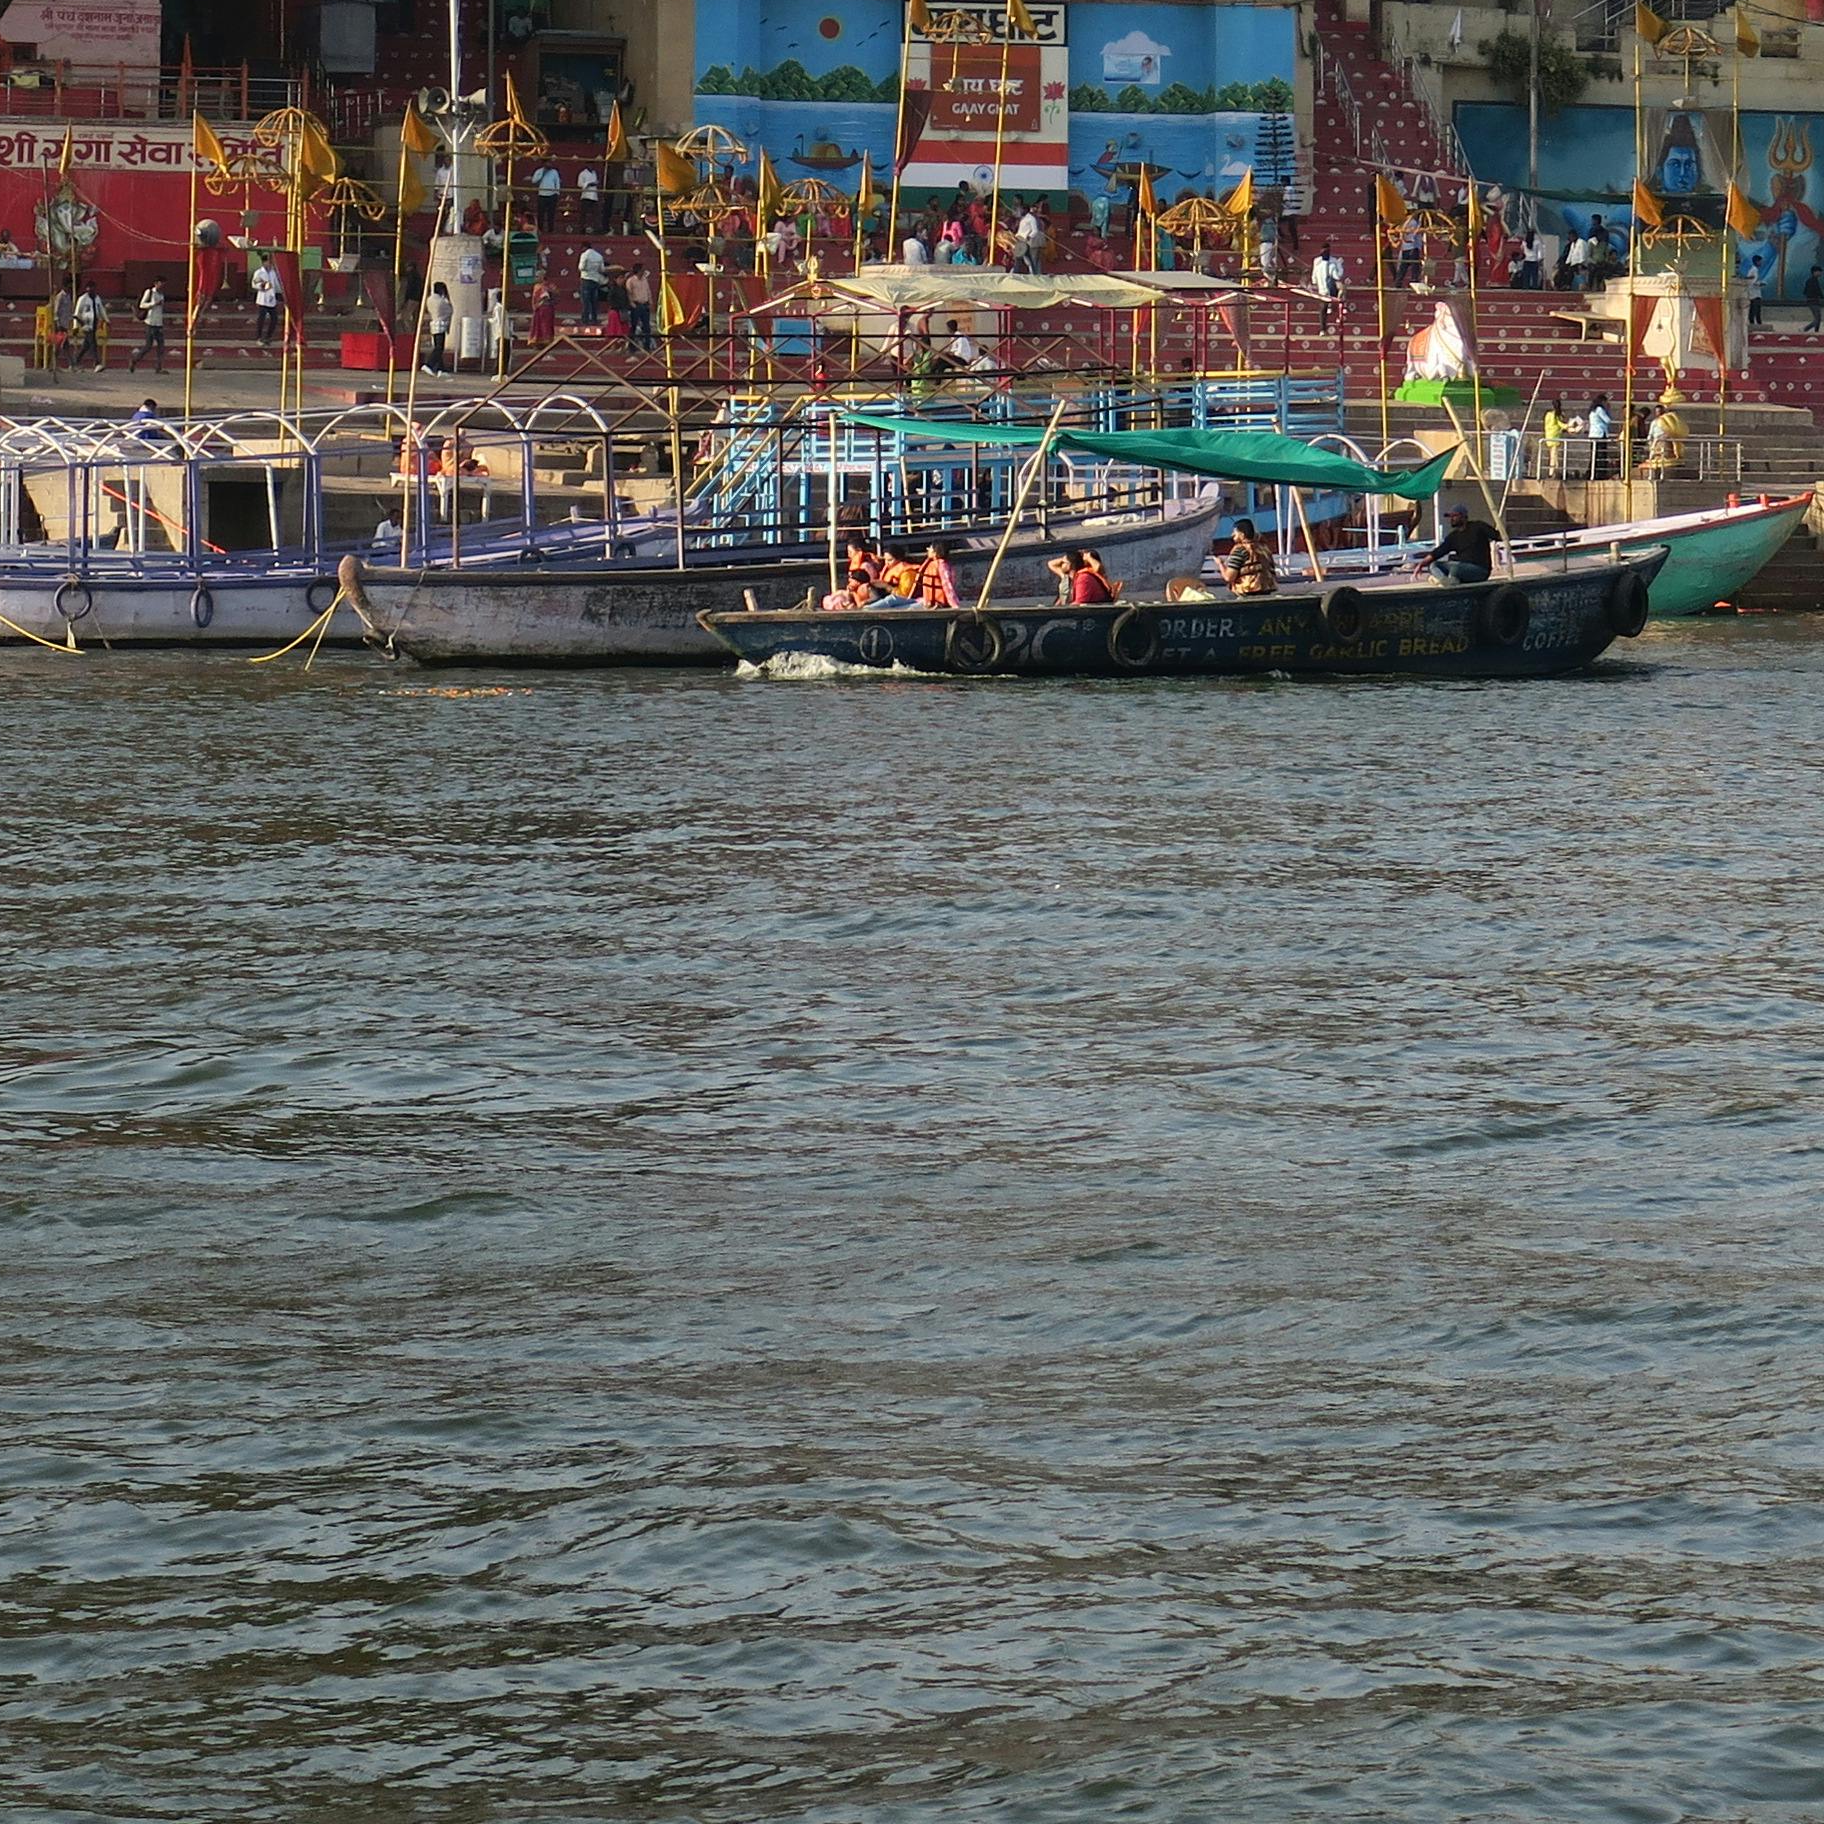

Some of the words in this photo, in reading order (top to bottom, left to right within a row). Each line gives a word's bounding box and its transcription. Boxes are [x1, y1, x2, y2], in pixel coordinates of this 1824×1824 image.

[951, 102, 987, 115] GAAY
[118, 134, 185, 166] सेवा
[869, 627, 880, 658] 1
[1398, 635, 1470, 657] BREAD
